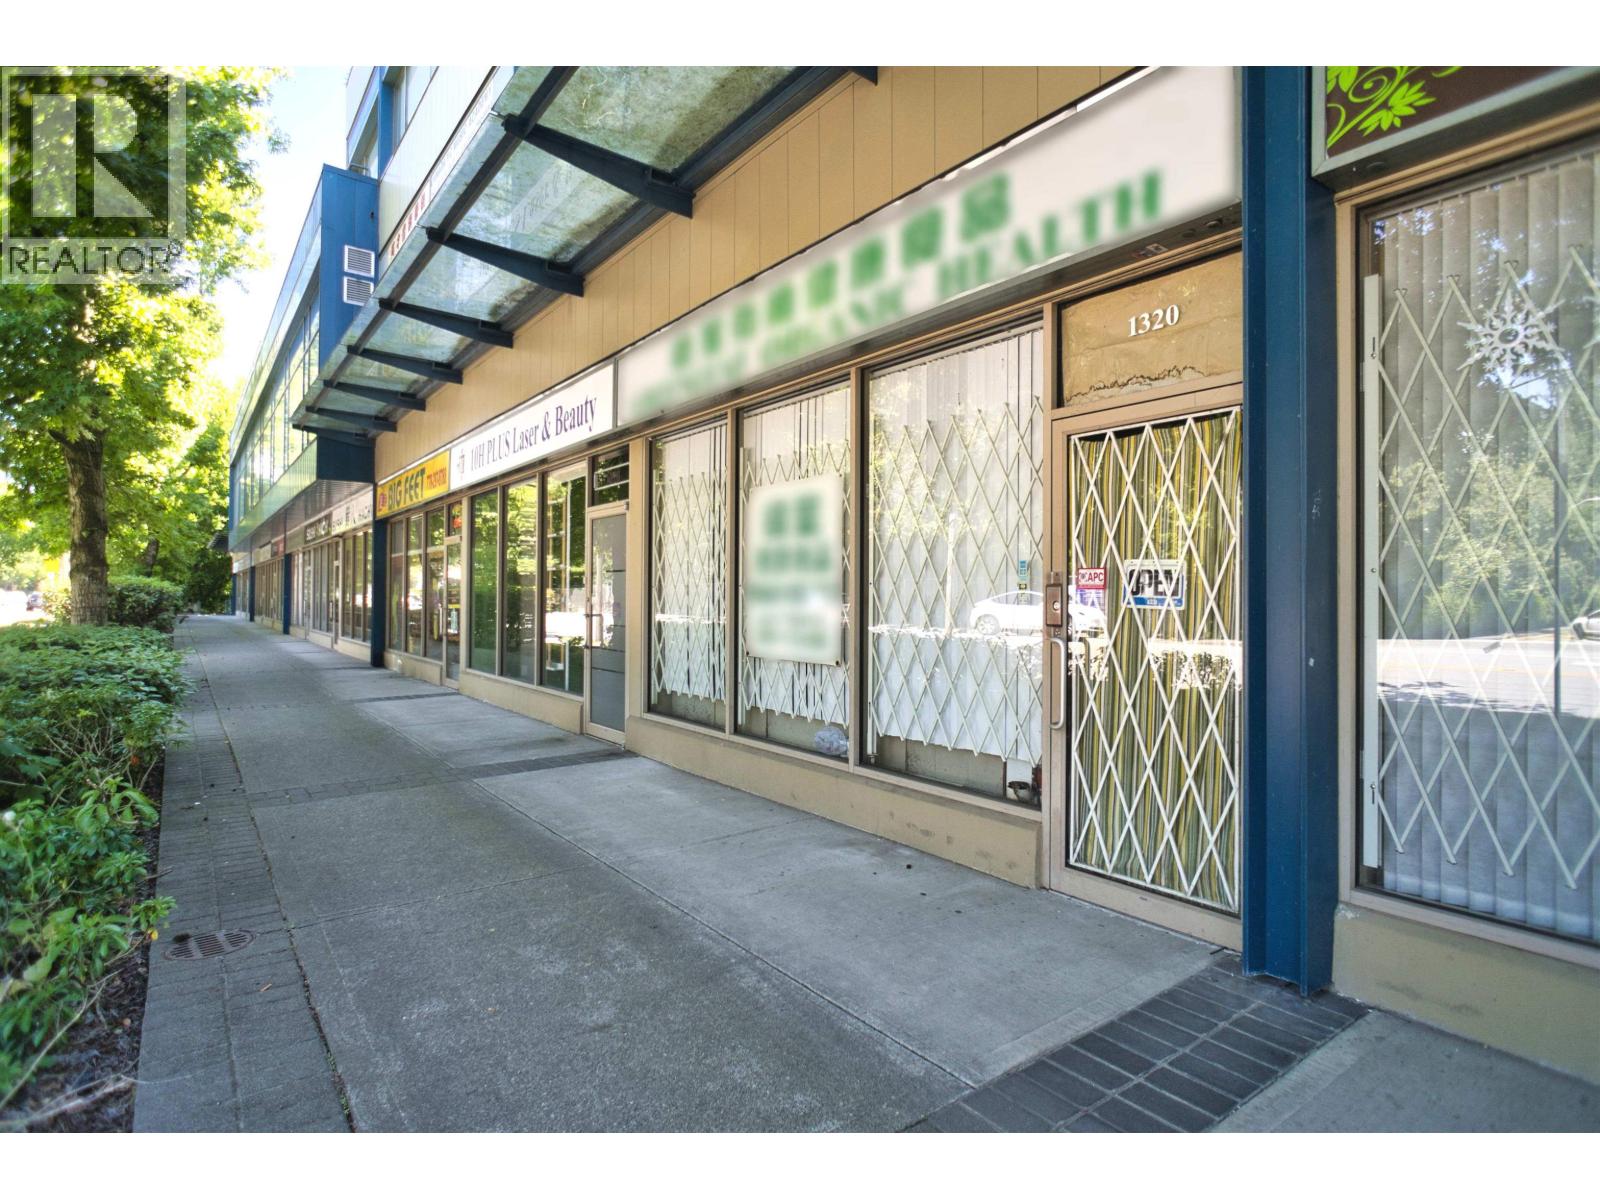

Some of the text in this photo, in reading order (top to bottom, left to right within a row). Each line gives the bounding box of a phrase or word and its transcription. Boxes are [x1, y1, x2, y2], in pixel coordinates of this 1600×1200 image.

[1128, 304, 1180, 337] 1320
[487, 430, 510, 465] PLUS
[512, 424, 539, 454] Laser
[541, 411, 552, 442] &
[555, 397, 597, 436] Beauty
[388, 478, 402, 511] BIG
[403, 466, 426, 506] FEET
[1087, 572, 1104, 582] APC
[1128, 568, 1180, 596] OPEN
